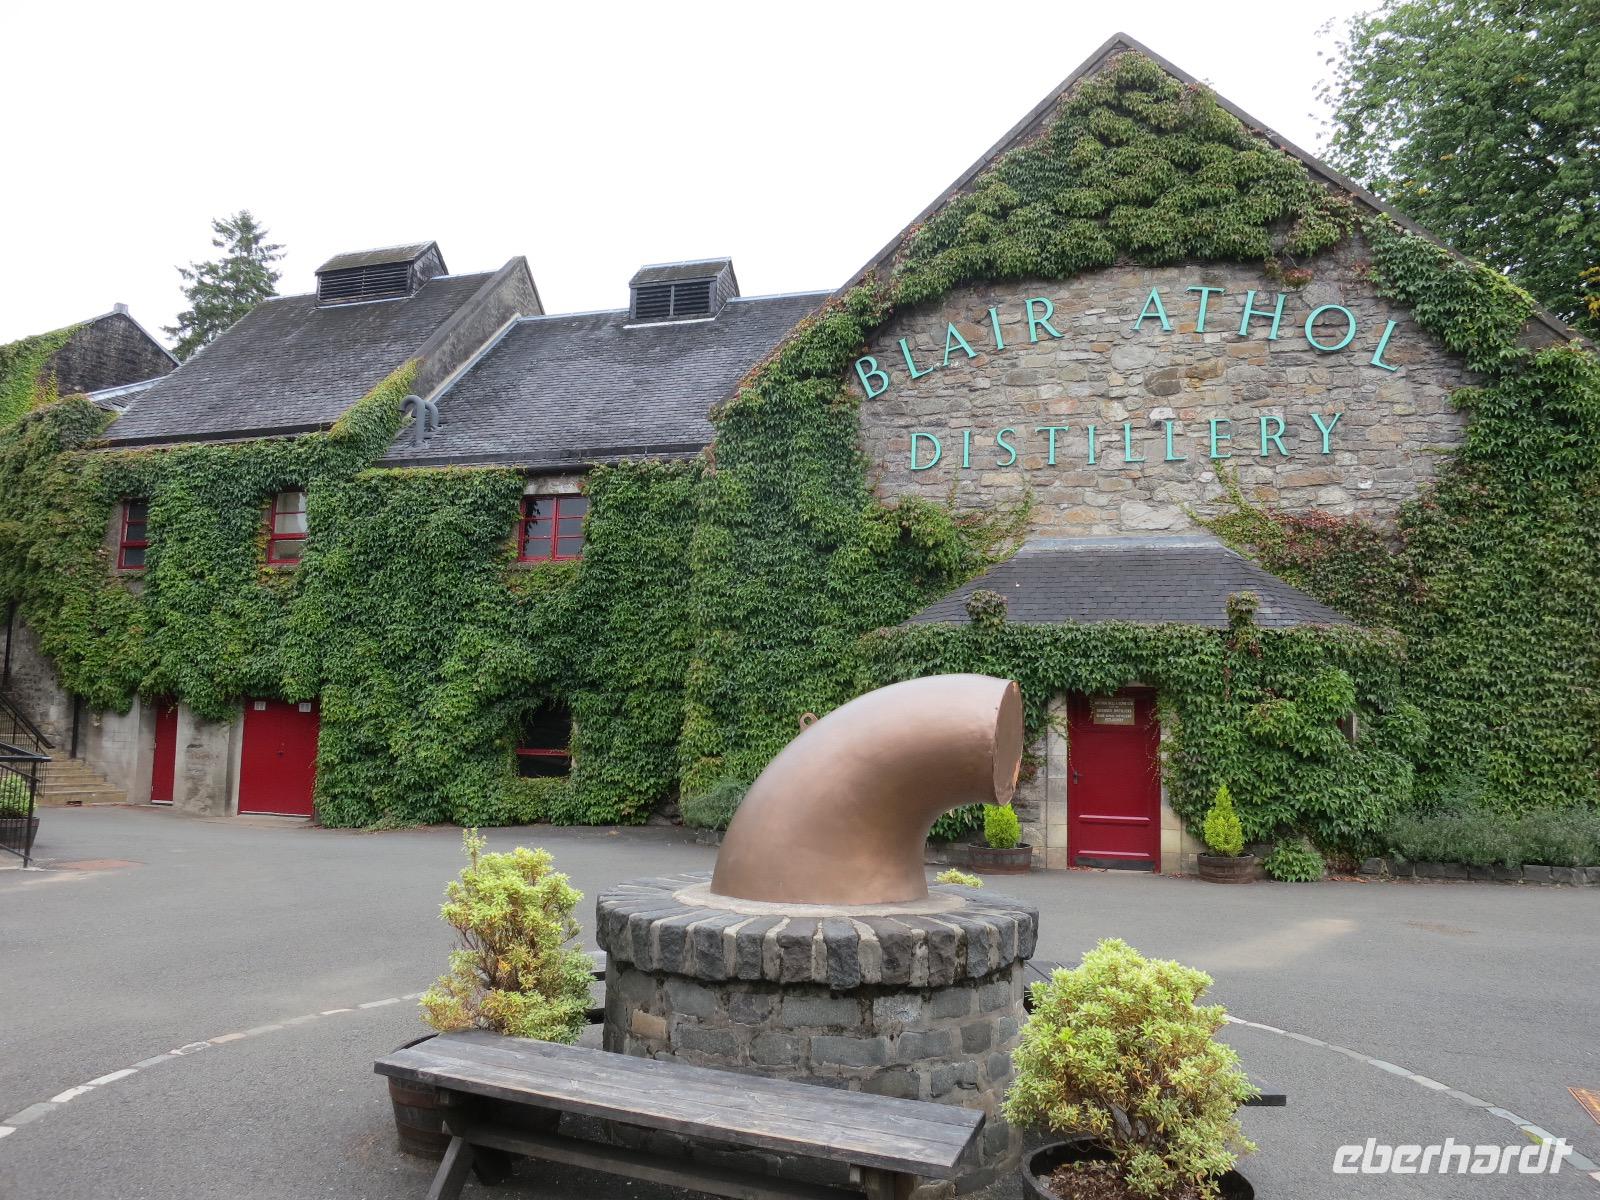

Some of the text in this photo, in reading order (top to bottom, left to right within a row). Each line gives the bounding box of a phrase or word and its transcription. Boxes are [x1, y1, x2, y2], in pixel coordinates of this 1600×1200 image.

[854, 286, 1400, 399] BLAIR ATHOL
[909, 412, 1343, 471] DISTILLERY
